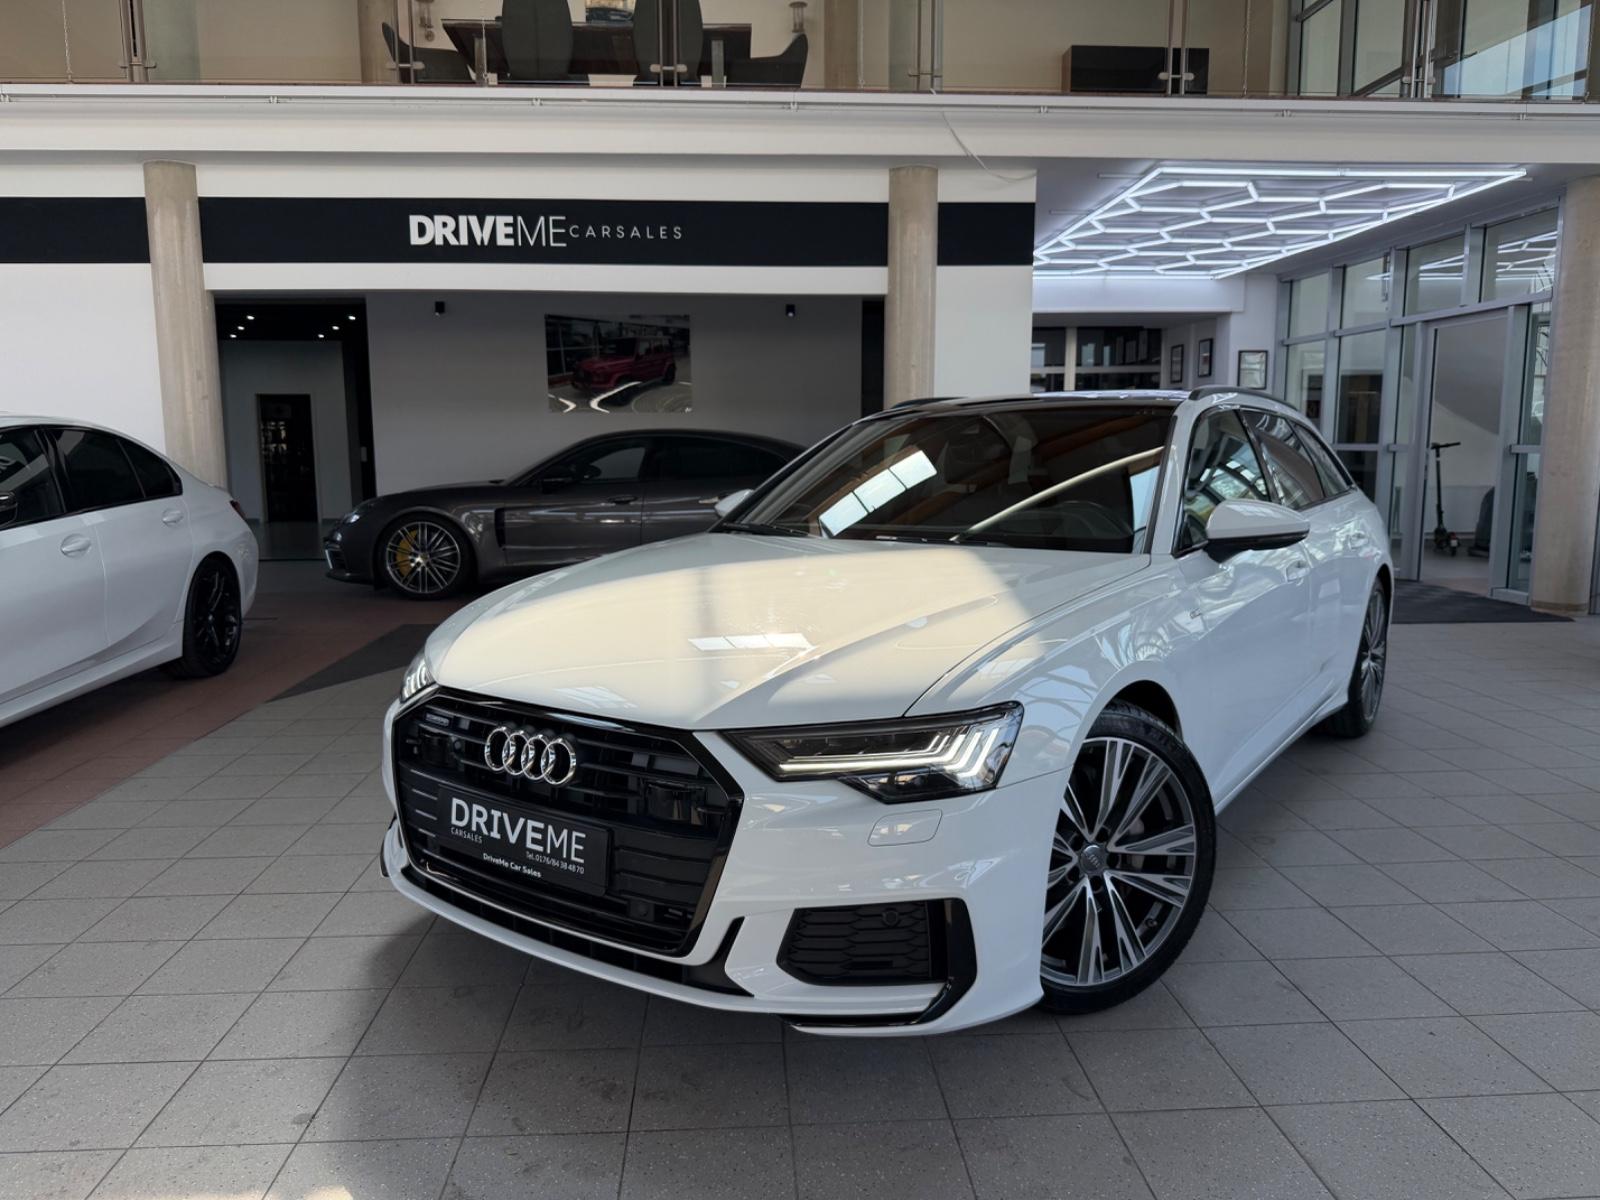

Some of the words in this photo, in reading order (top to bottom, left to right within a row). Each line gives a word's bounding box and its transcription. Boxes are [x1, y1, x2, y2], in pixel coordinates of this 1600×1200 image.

[409, 214, 567, 247] DRIVEME
[569, 225, 683, 239] CARSALES
[450, 797, 586, 864] DRIVEME
[450, 827, 483, 844] CARSALES
[483, 852, 509, 868] DriveMe
[510, 861, 521, 872] Car
[522, 865, 542, 878] Sales
